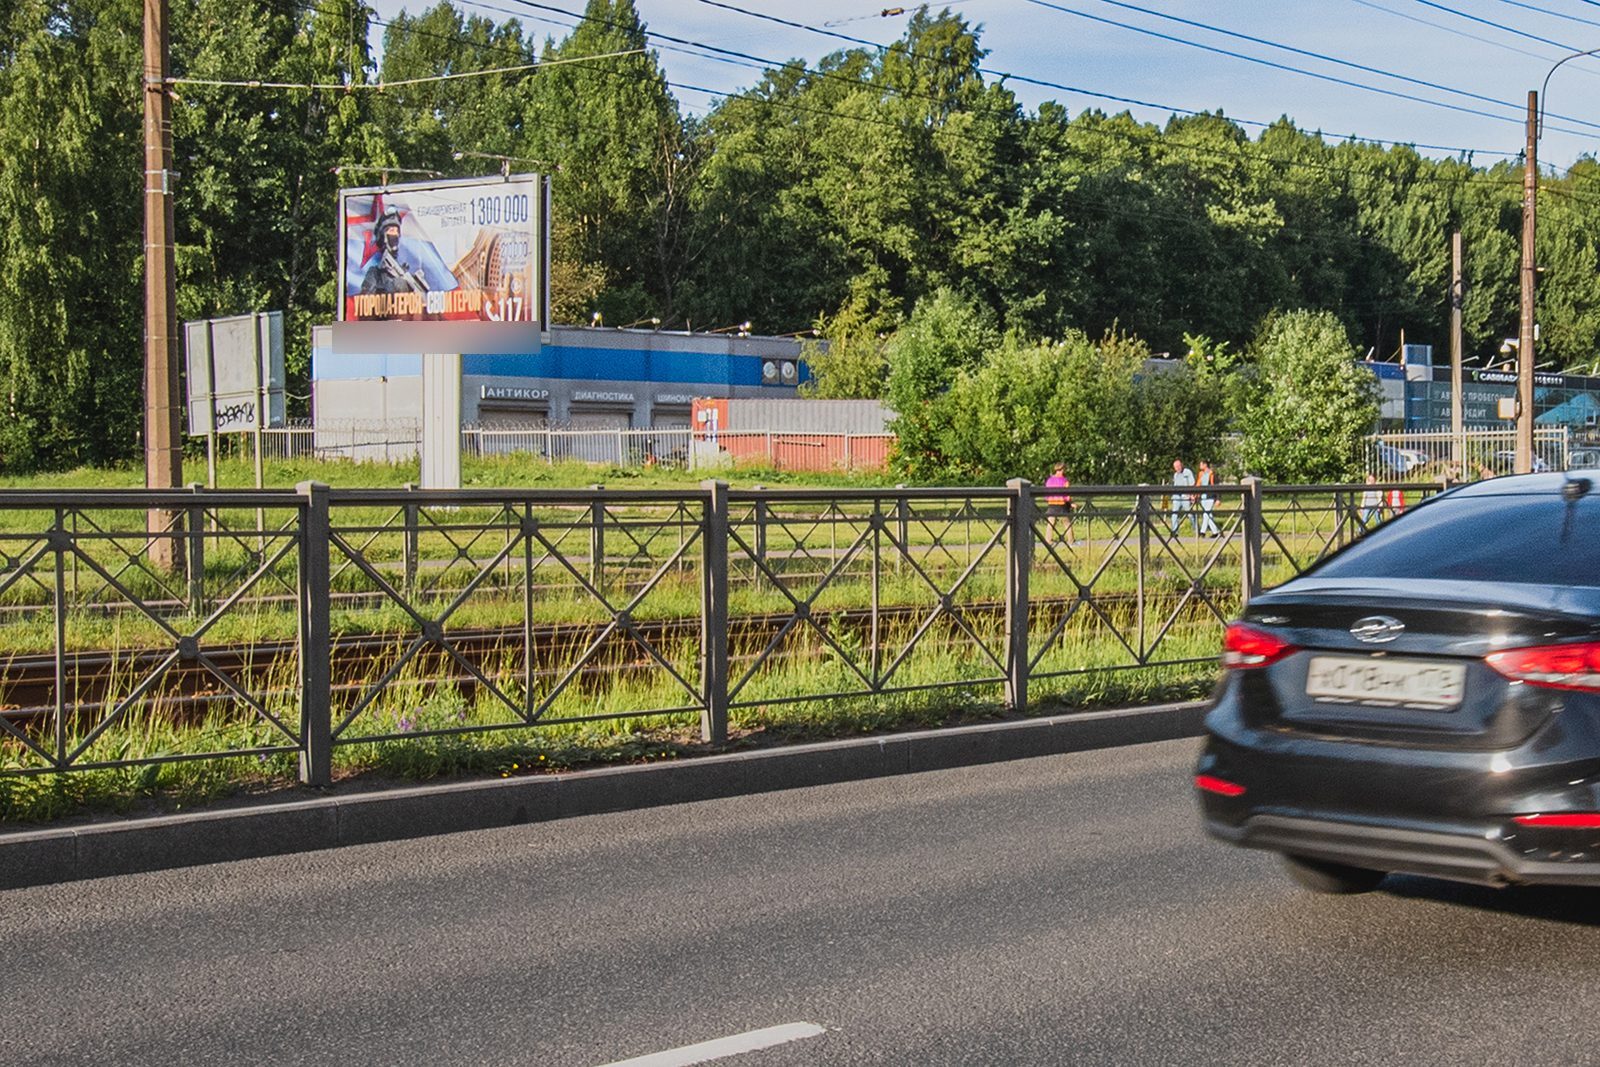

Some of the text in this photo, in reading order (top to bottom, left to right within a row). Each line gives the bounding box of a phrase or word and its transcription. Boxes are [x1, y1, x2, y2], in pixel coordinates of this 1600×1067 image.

[498, 297, 523, 322] 117
[487, 388, 549, 399] АНТИКОР
[575, 391, 635, 401] ДИАГНОСТИКА
